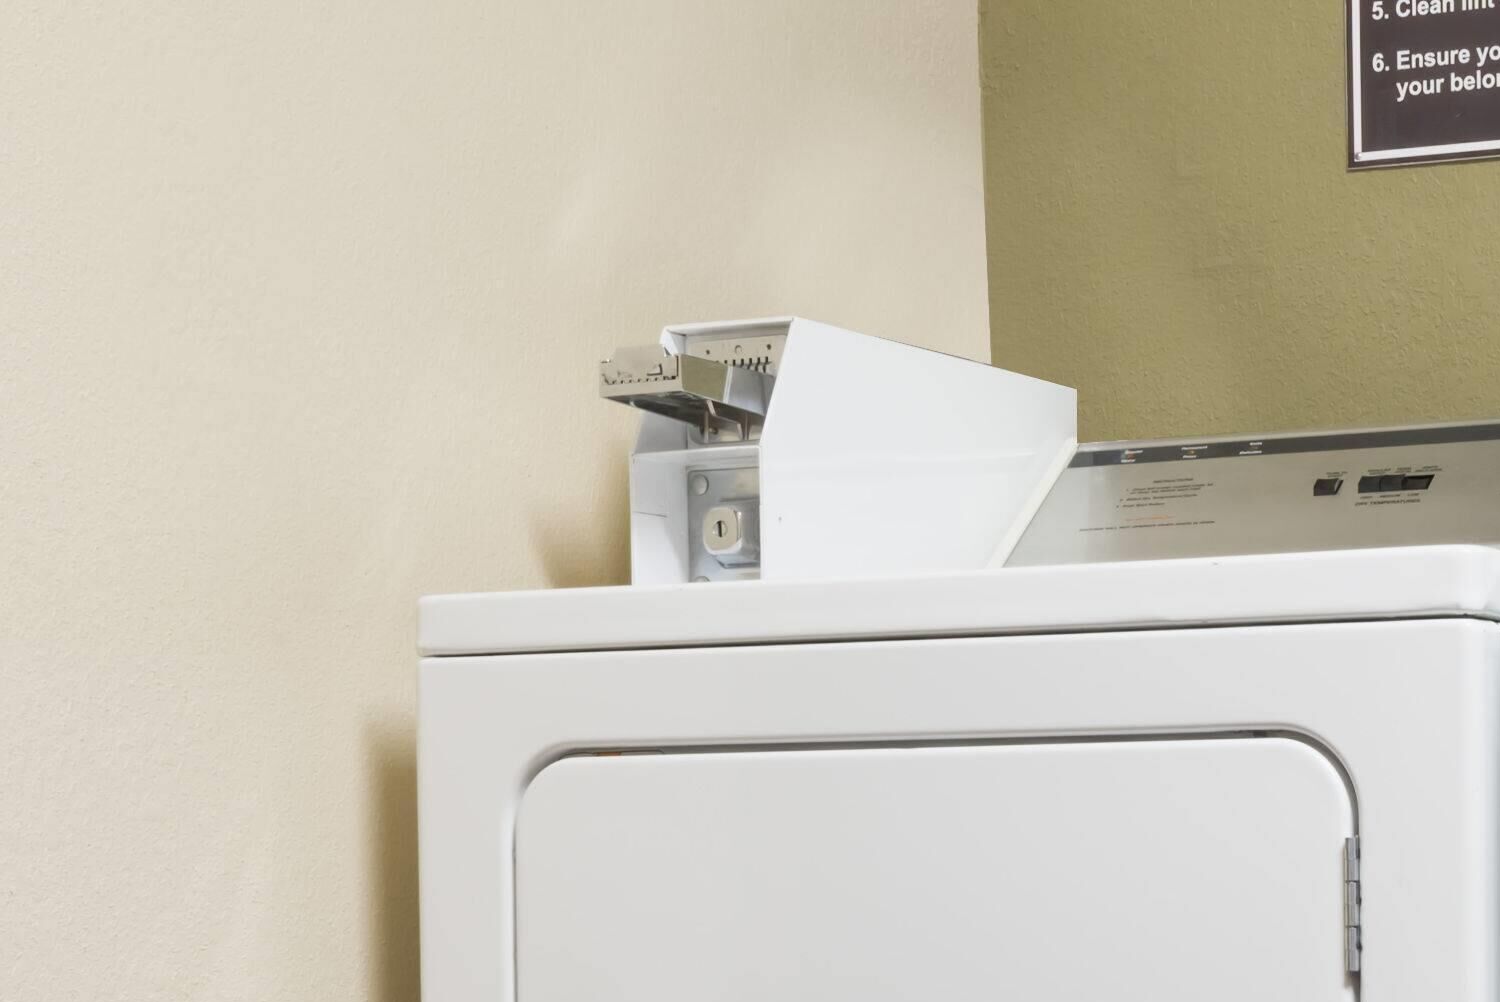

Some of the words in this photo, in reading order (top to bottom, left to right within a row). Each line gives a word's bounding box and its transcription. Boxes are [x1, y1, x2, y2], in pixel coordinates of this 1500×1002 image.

[1371, 0, 1390, 20] 5.
[1395, 0, 1455, 18] Clean
[1372, 53, 1390, 73] 6.
[1396, 48, 1471, 70] Ensure
[1396, 75, 1445, 102] your
